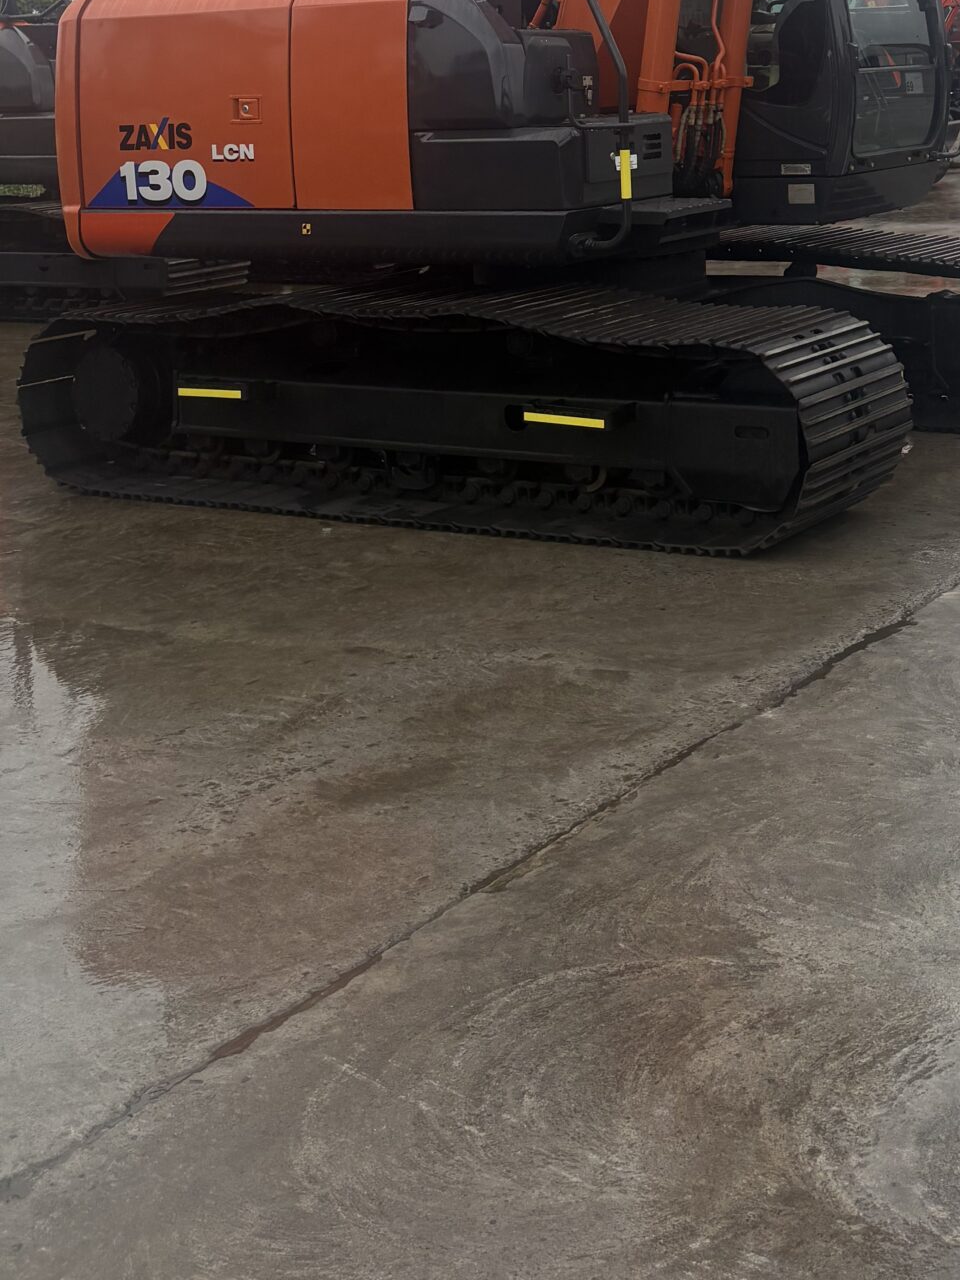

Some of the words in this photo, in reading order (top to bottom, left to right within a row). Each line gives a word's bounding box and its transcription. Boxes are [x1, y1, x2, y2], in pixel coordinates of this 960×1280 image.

[118, 117, 193, 151] ZAXIS
[211, 143, 255, 161] LCN
[119, 159, 207, 202] 130
